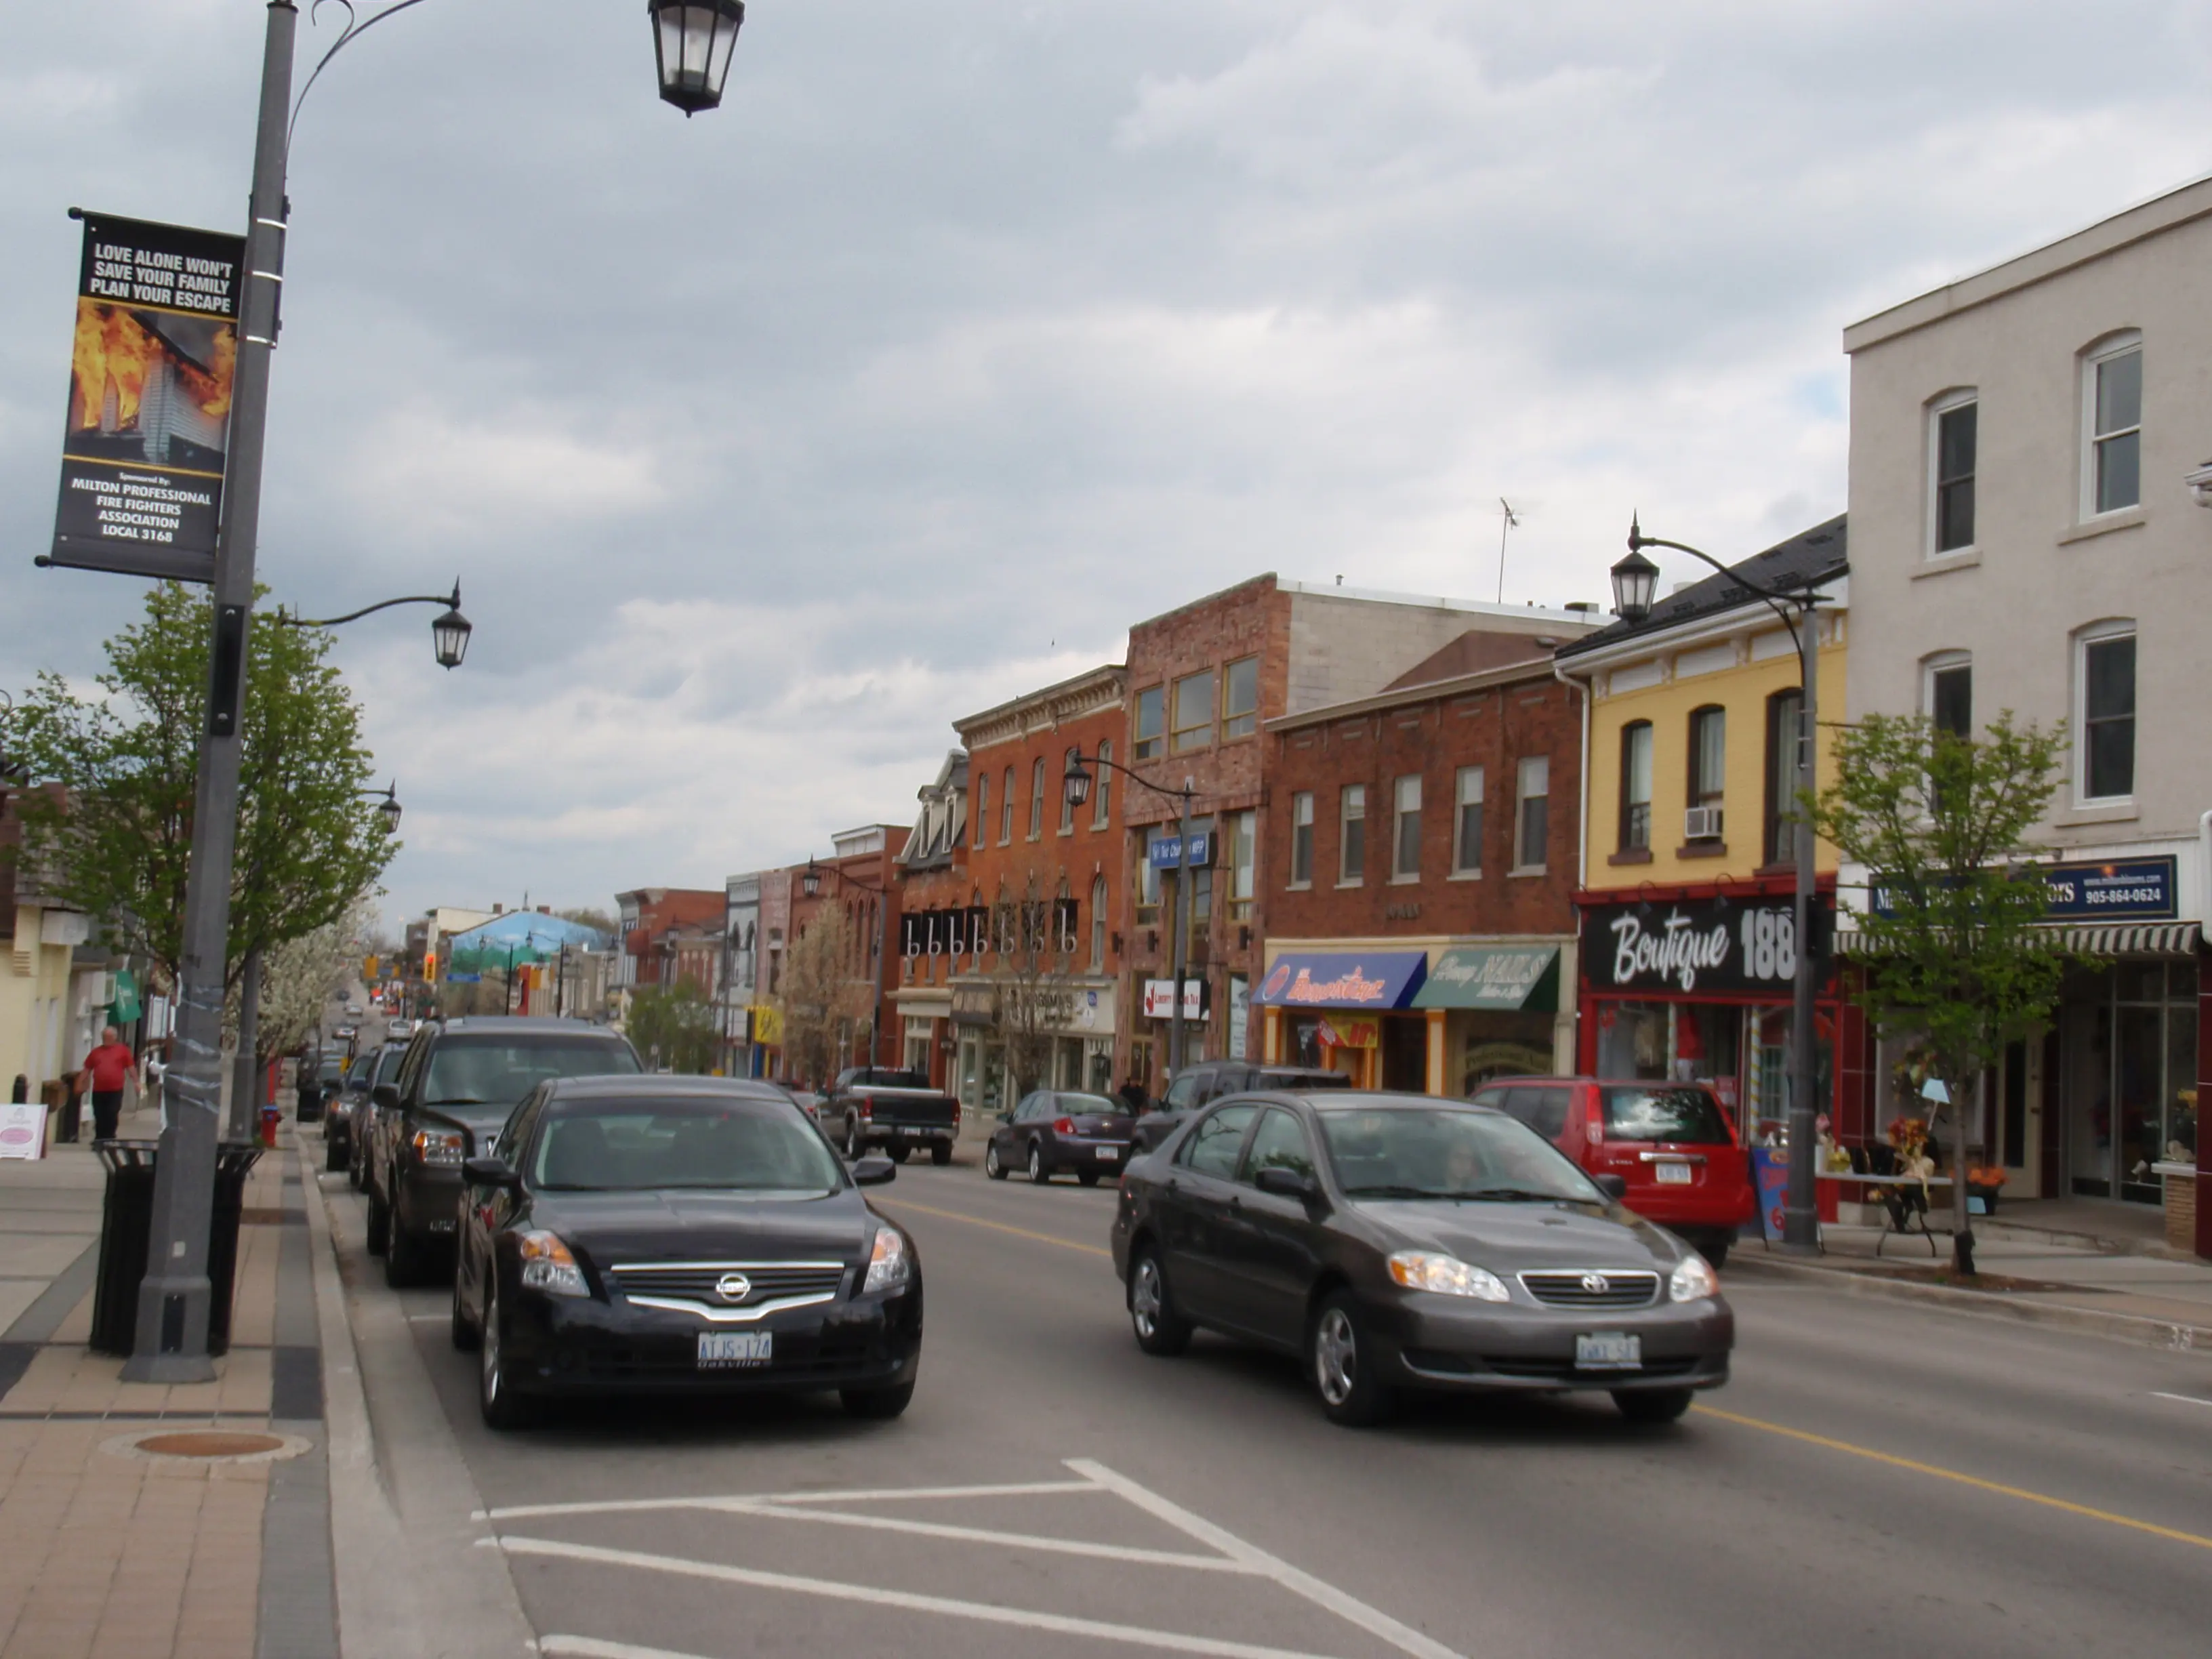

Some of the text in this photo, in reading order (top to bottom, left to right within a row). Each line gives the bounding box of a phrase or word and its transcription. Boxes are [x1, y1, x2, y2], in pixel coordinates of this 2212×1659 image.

[94, 243, 233, 278] LOVE ALONE WON'T
[94, 261, 230, 295] SAVE YOUR FAMILY
[90, 278, 231, 313] PLAN YOUR ESCAPE
[119, 472, 157, 484] Sponsored
[71, 478, 212, 505] MILTON PROFESSIONAL
[96, 495, 182, 515] FIRE FIGHTERS
[98, 510, 180, 529] ASSOCIATION
[102, 524, 173, 542] LOCAL 3168
[2085, 888, 2161, 905] 905-864-0624
[1610, 905, 1796, 993] Boutique 188
